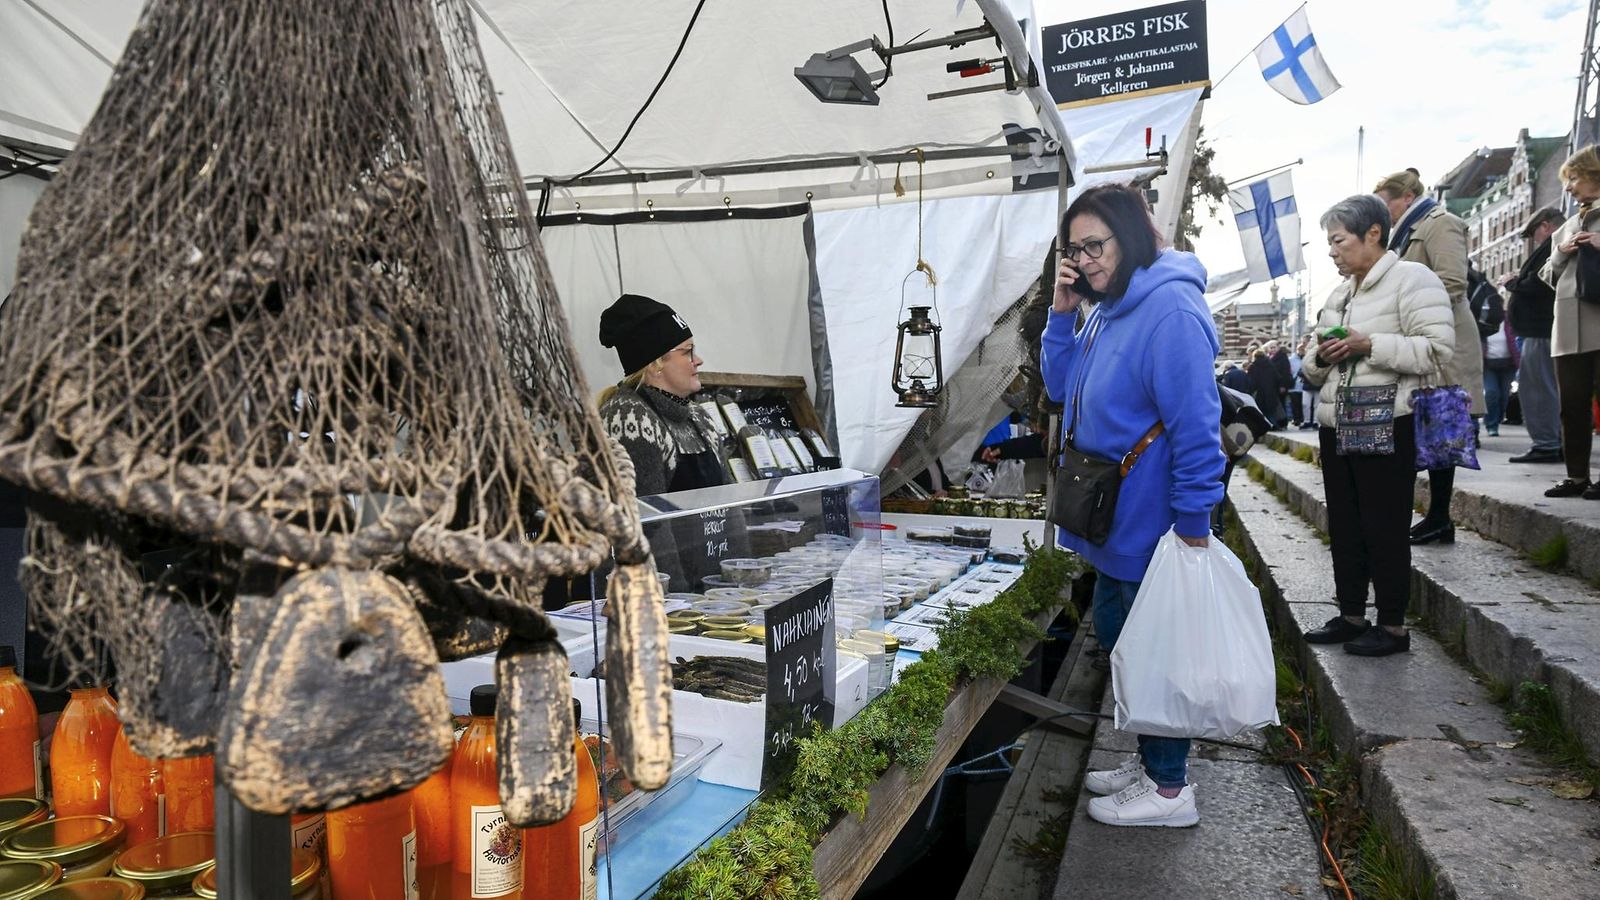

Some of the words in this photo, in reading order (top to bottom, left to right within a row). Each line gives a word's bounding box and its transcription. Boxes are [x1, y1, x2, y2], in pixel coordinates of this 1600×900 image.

[1058, 22, 1136, 54] JÖRRES
[1143, 12, 1190, 36] FISK
[1051, 57, 1108, 73] YRKESFISKARE
[1113, 42, 1198, 63] AMMATTIKALASTAJA
[1074, 69, 1111, 86] Jörgen
[1115, 67, 1124, 77] &
[1127, 60, 1175, 78] Johanna
[1100, 80, 1148, 95] Kellgren
[771, 732, 780, 757] 3
